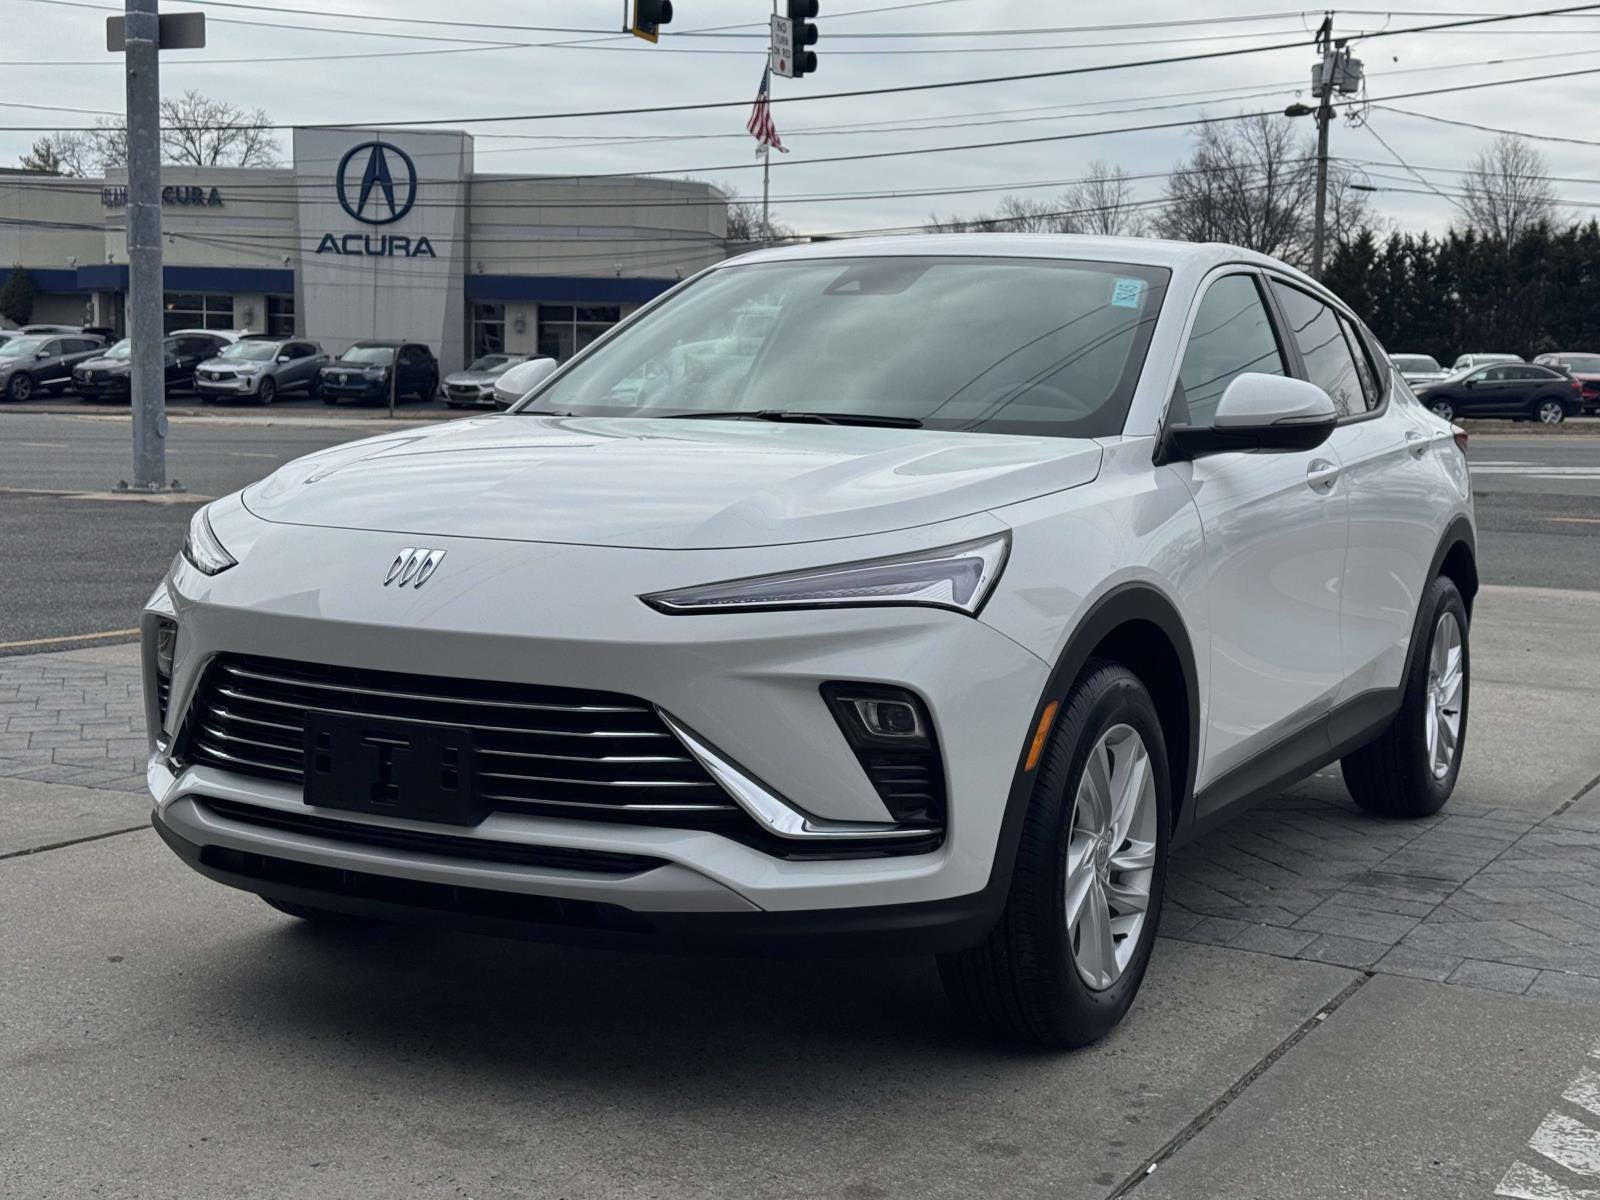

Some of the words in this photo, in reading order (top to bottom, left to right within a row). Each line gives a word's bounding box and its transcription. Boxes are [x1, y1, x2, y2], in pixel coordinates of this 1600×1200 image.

[777, 21, 787, 34] NO
[776, 34, 788, 46] TURN
[774, 46, 780, 56] ON
[782, 48, 791, 58] RED
[161, 186, 223, 206] CURA
[315, 233, 436, 258] ACURA
